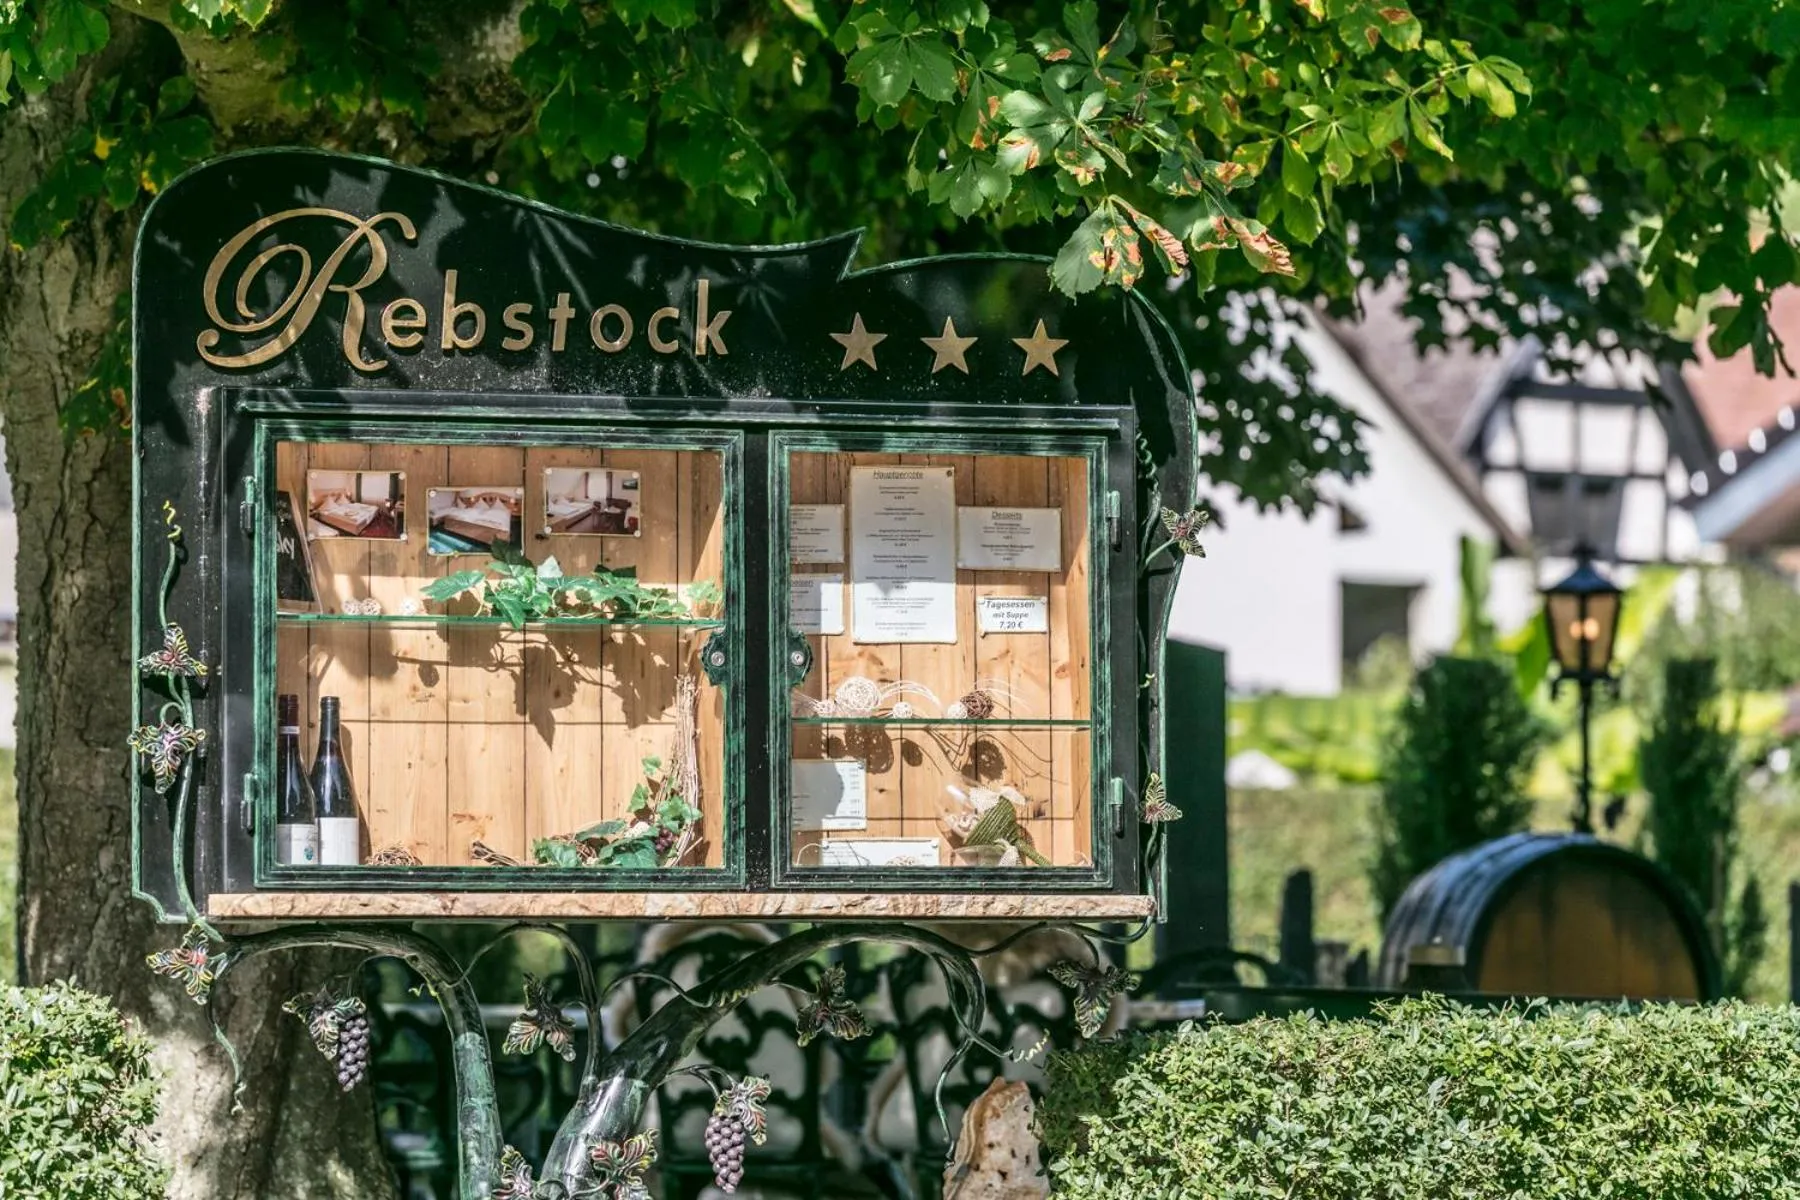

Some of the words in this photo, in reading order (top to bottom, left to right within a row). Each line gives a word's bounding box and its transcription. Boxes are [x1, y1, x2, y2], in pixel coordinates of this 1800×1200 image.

[197, 207, 732, 371] Rebstock
[986, 600, 1035, 610] Tagesessen
[1006, 611, 1029, 620] Suppe
[1017, 621, 1024, 629] €
